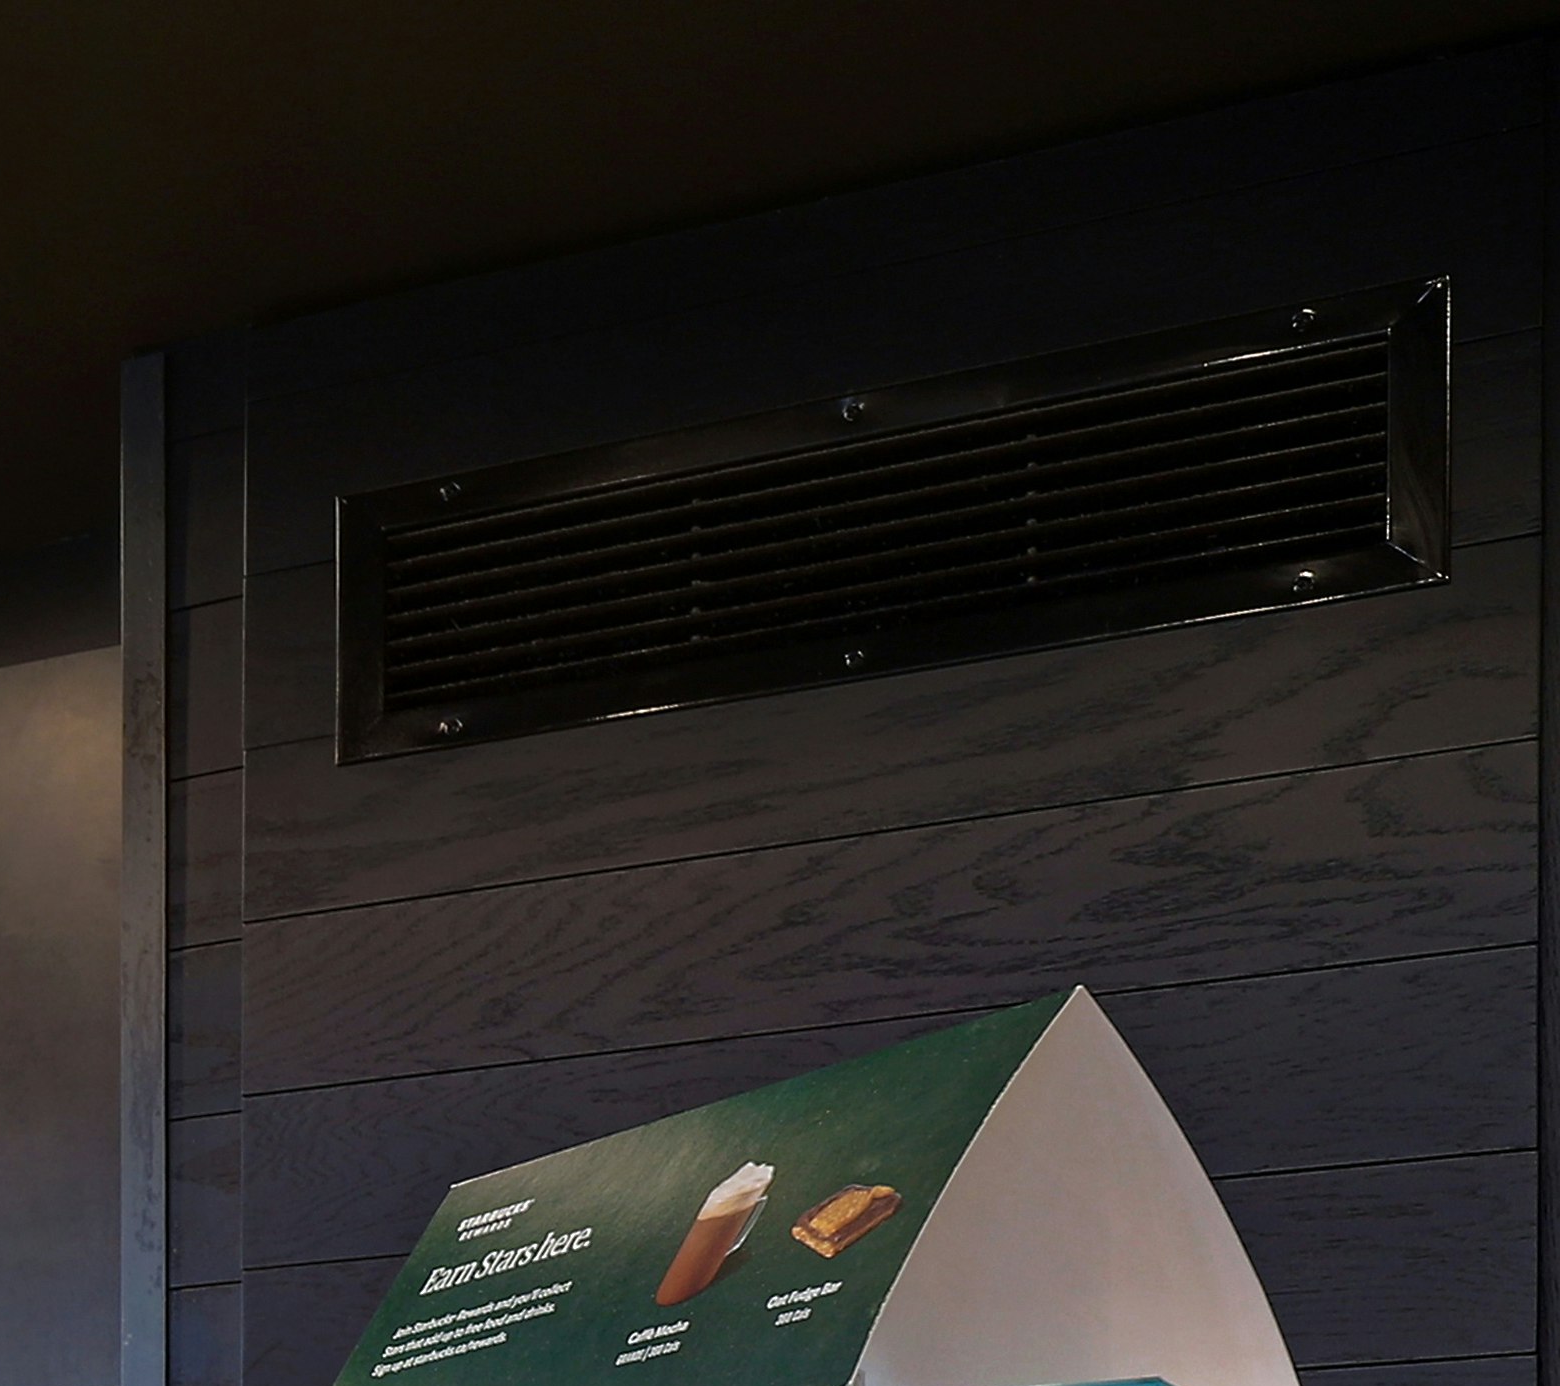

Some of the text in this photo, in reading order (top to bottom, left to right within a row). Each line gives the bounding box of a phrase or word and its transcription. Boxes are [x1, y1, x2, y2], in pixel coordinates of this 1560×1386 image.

[420, 1228, 593, 1296] Earn Stars here.
